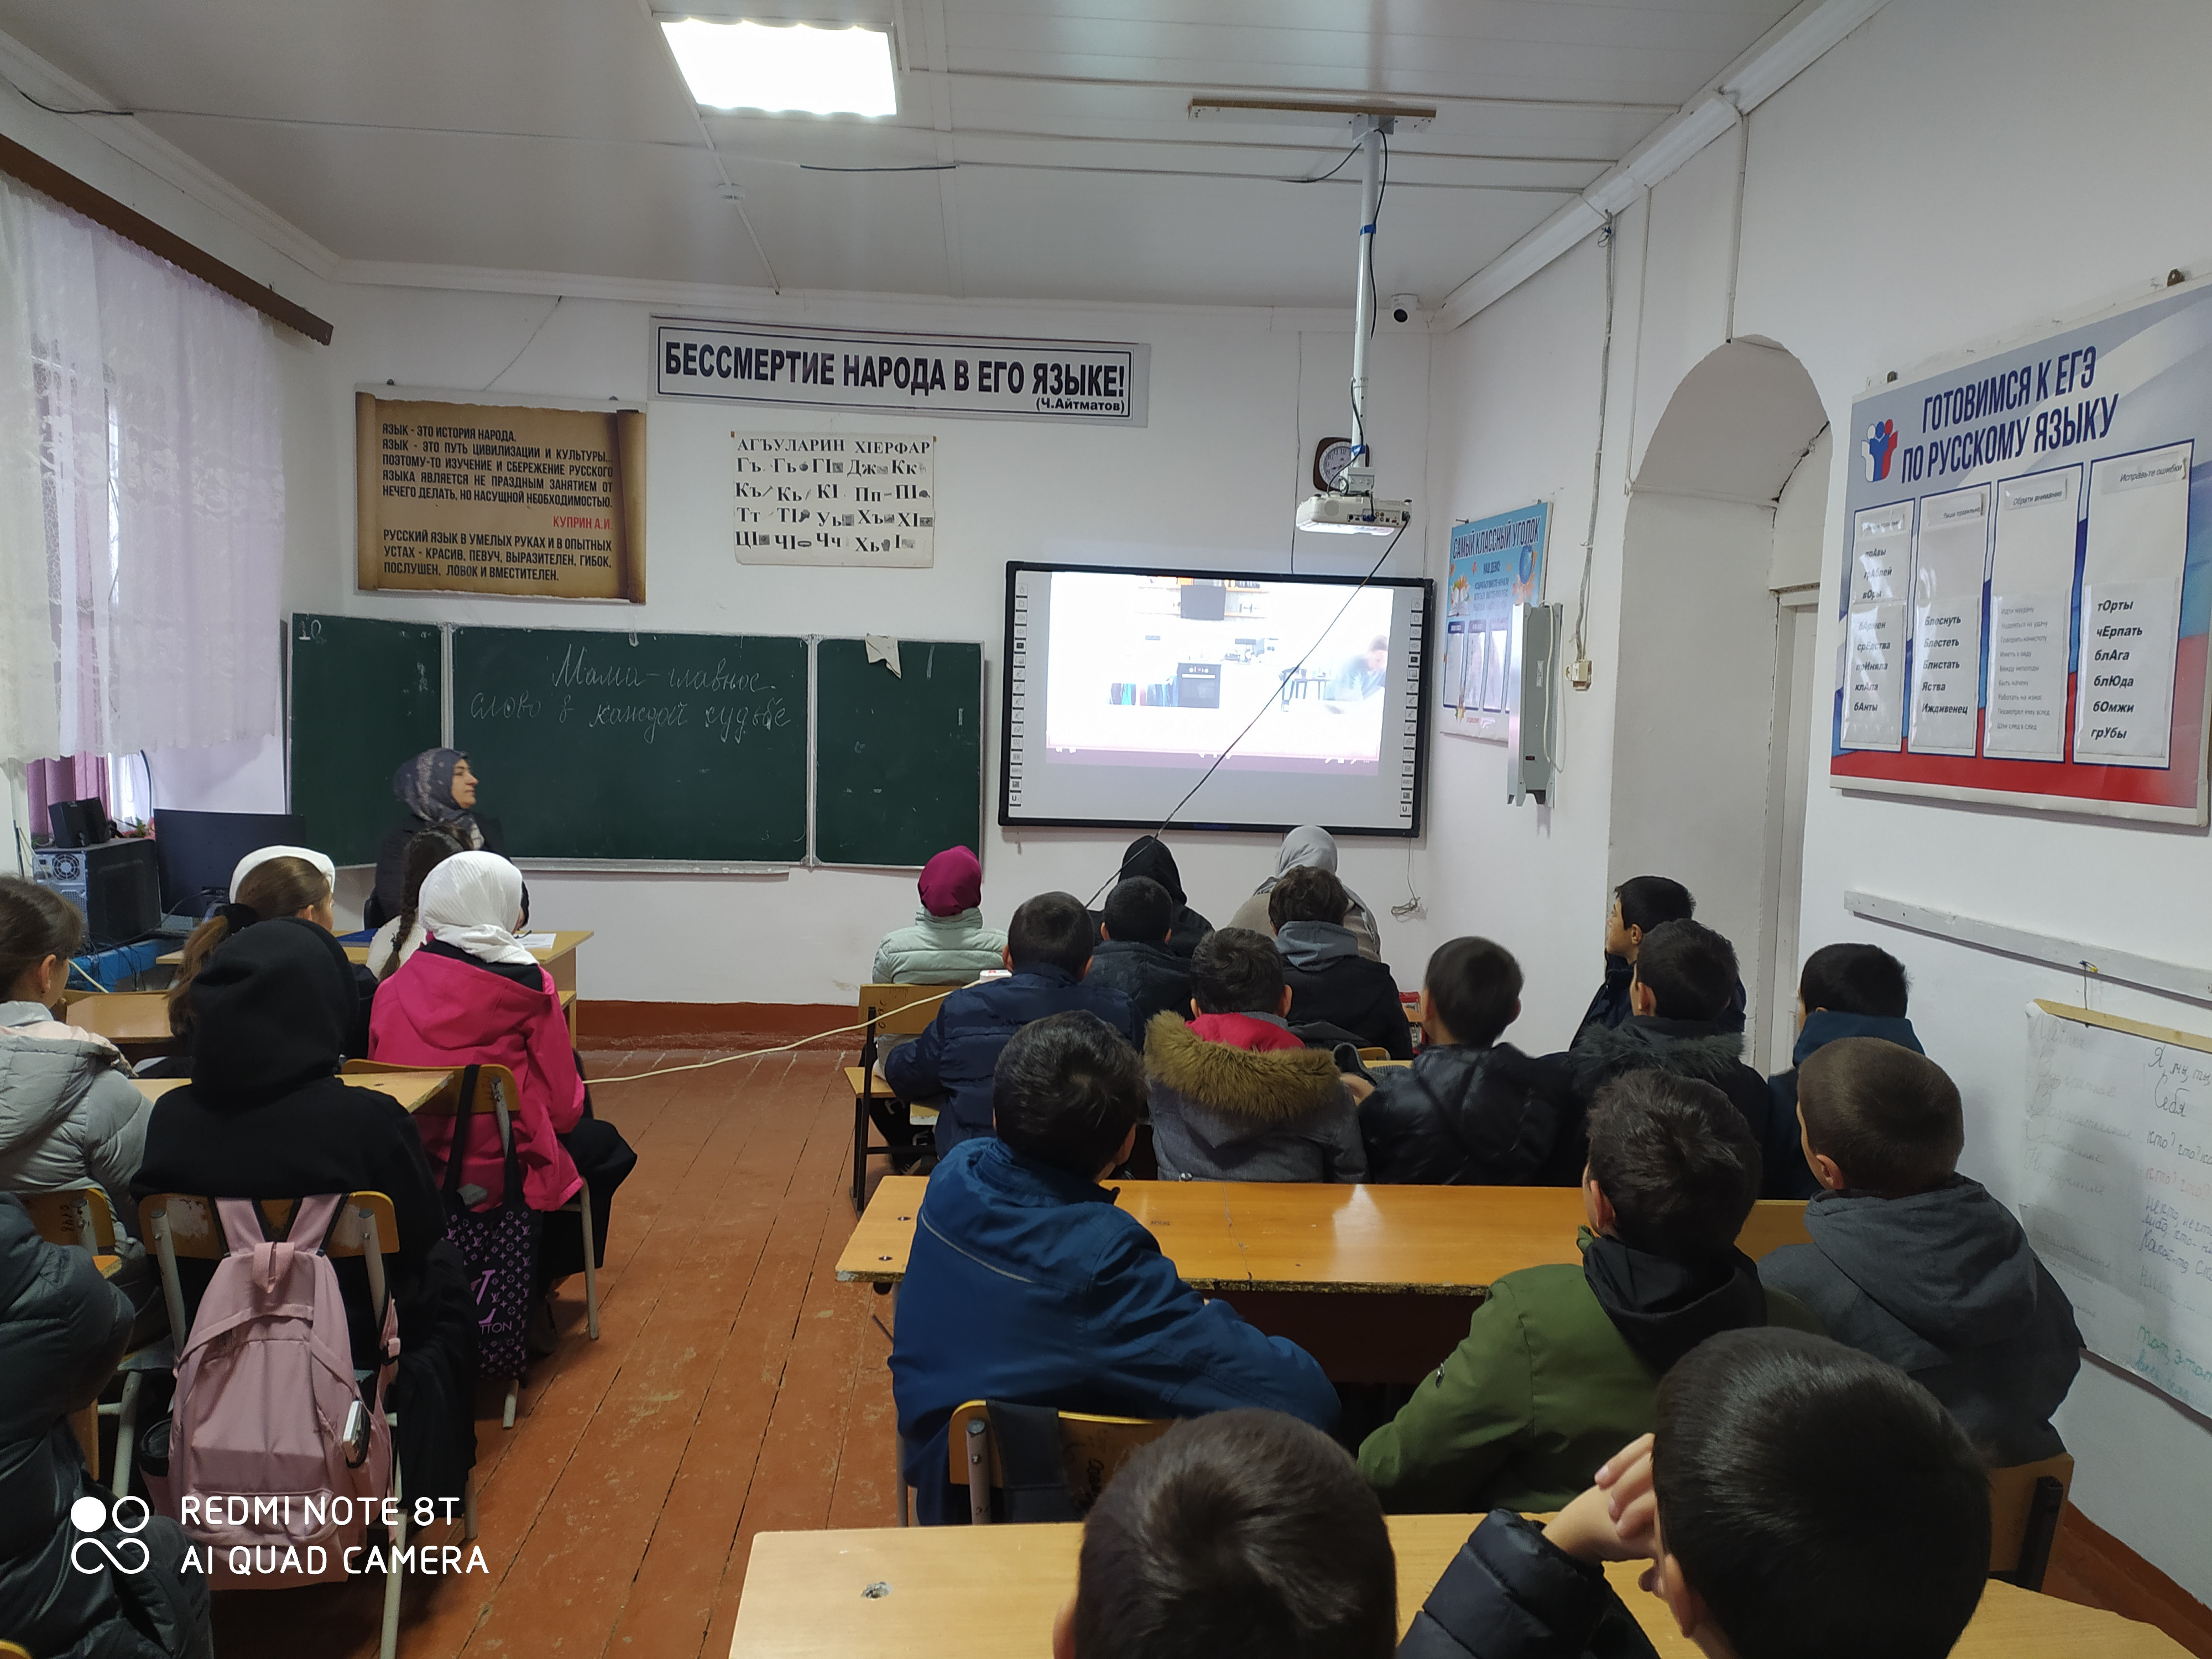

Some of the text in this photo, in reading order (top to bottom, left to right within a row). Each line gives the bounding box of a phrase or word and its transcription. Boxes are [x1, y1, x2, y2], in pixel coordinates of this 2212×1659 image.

[665, 341, 1125, 397] БЕССМЕРТИЕ НАРОДА В ЕГО ЯЗЫКЕ!
[1922, 345, 2097, 434] ГОТОВИМСЯ К ЕГЭ
[1035, 398, 1126, 414] (Ч.Айтматов)
[383, 423, 408, 435] ЯЗЫК
[417, 425, 434, 437] ЭТО
[436, 426, 476, 439] ИСТОРИЯ
[478, 429, 517, 442] НАРОДА.
[1902, 393, 2120, 484] ПО РУССКОМУ ЯЗЫКУ
[383, 439, 408, 451] ЯЗЫК
[422, 441, 440, 452] ЭТО
[444, 442, 468, 454] ПУТЬ
[473, 444, 540, 458] ЦИВИЛИЗАЦИИ
[545, 448, 551, 459] И
[556, 448, 613, 463] КУЛЬТУРЫ...
[737, 439, 844, 451] АГЪУЛАРИН
[383, 454, 613, 478] ПОЭТОМУ-ТО ИЗУЧЕНИЕ И СБЕРЕЖЕНИЕ РУССКОГО
[2120, 463, 2183, 482] Исправьте ошибки
[383, 469, 612, 493] ЯЗЫКА ЯВЛЯЕТСЯ НЕ ПРАЗДНЫМ ЗАНЯТИЕМ ОТ
[383, 484, 613, 508] НЕЧЕГО ДЕЛАТЬ, НО НАСУЩНОЙ НЕОБХОДИМОСТЬЮ.
[2013, 496, 2033, 505] Обрати
[553, 516, 613, 530] КУПРИН А.И.
[383, 529, 612, 552] РУССКИЙ ЯЗЫК В УМЕЛЫХ РУКАХ И В ОПЫТНЫХ
[1453, 517, 1541, 559] САМЫЙ КЛАССНЫЙ УГОЛОК
[384, 545, 415, 558] УСТАХ
[425, 547, 466, 561] КРАСИВ,
[469, 549, 503, 564] ПЕВУЧ,
[505, 551, 576, 567] ВЫРАЗИТЕЛЕН,
[580, 555, 612, 568] ГИБОК,
[384, 562, 559, 581] ПОСЛУШЕН, ЛОВОК И ВМЕСТИТЕЛЕН.
[2098, 599, 2133, 613] тОрты
[1924, 616, 1961, 627] Блеснуть
[2096, 625, 2143, 639] чЕрпать
[1924, 638, 1959, 648] Блестеть
[2094, 649, 2130, 661] блАга
[1923, 659, 1960, 670] Блистать
[1922, 682, 1946, 692] Яства
[2094, 675, 2134, 688] блЮда
[1854, 702, 1878, 711] бАнты
[1922, 703, 1968, 716] Иждивенец
[2093, 701, 2134, 713] бОмжи
[2091, 727, 2127, 740] грУбы
